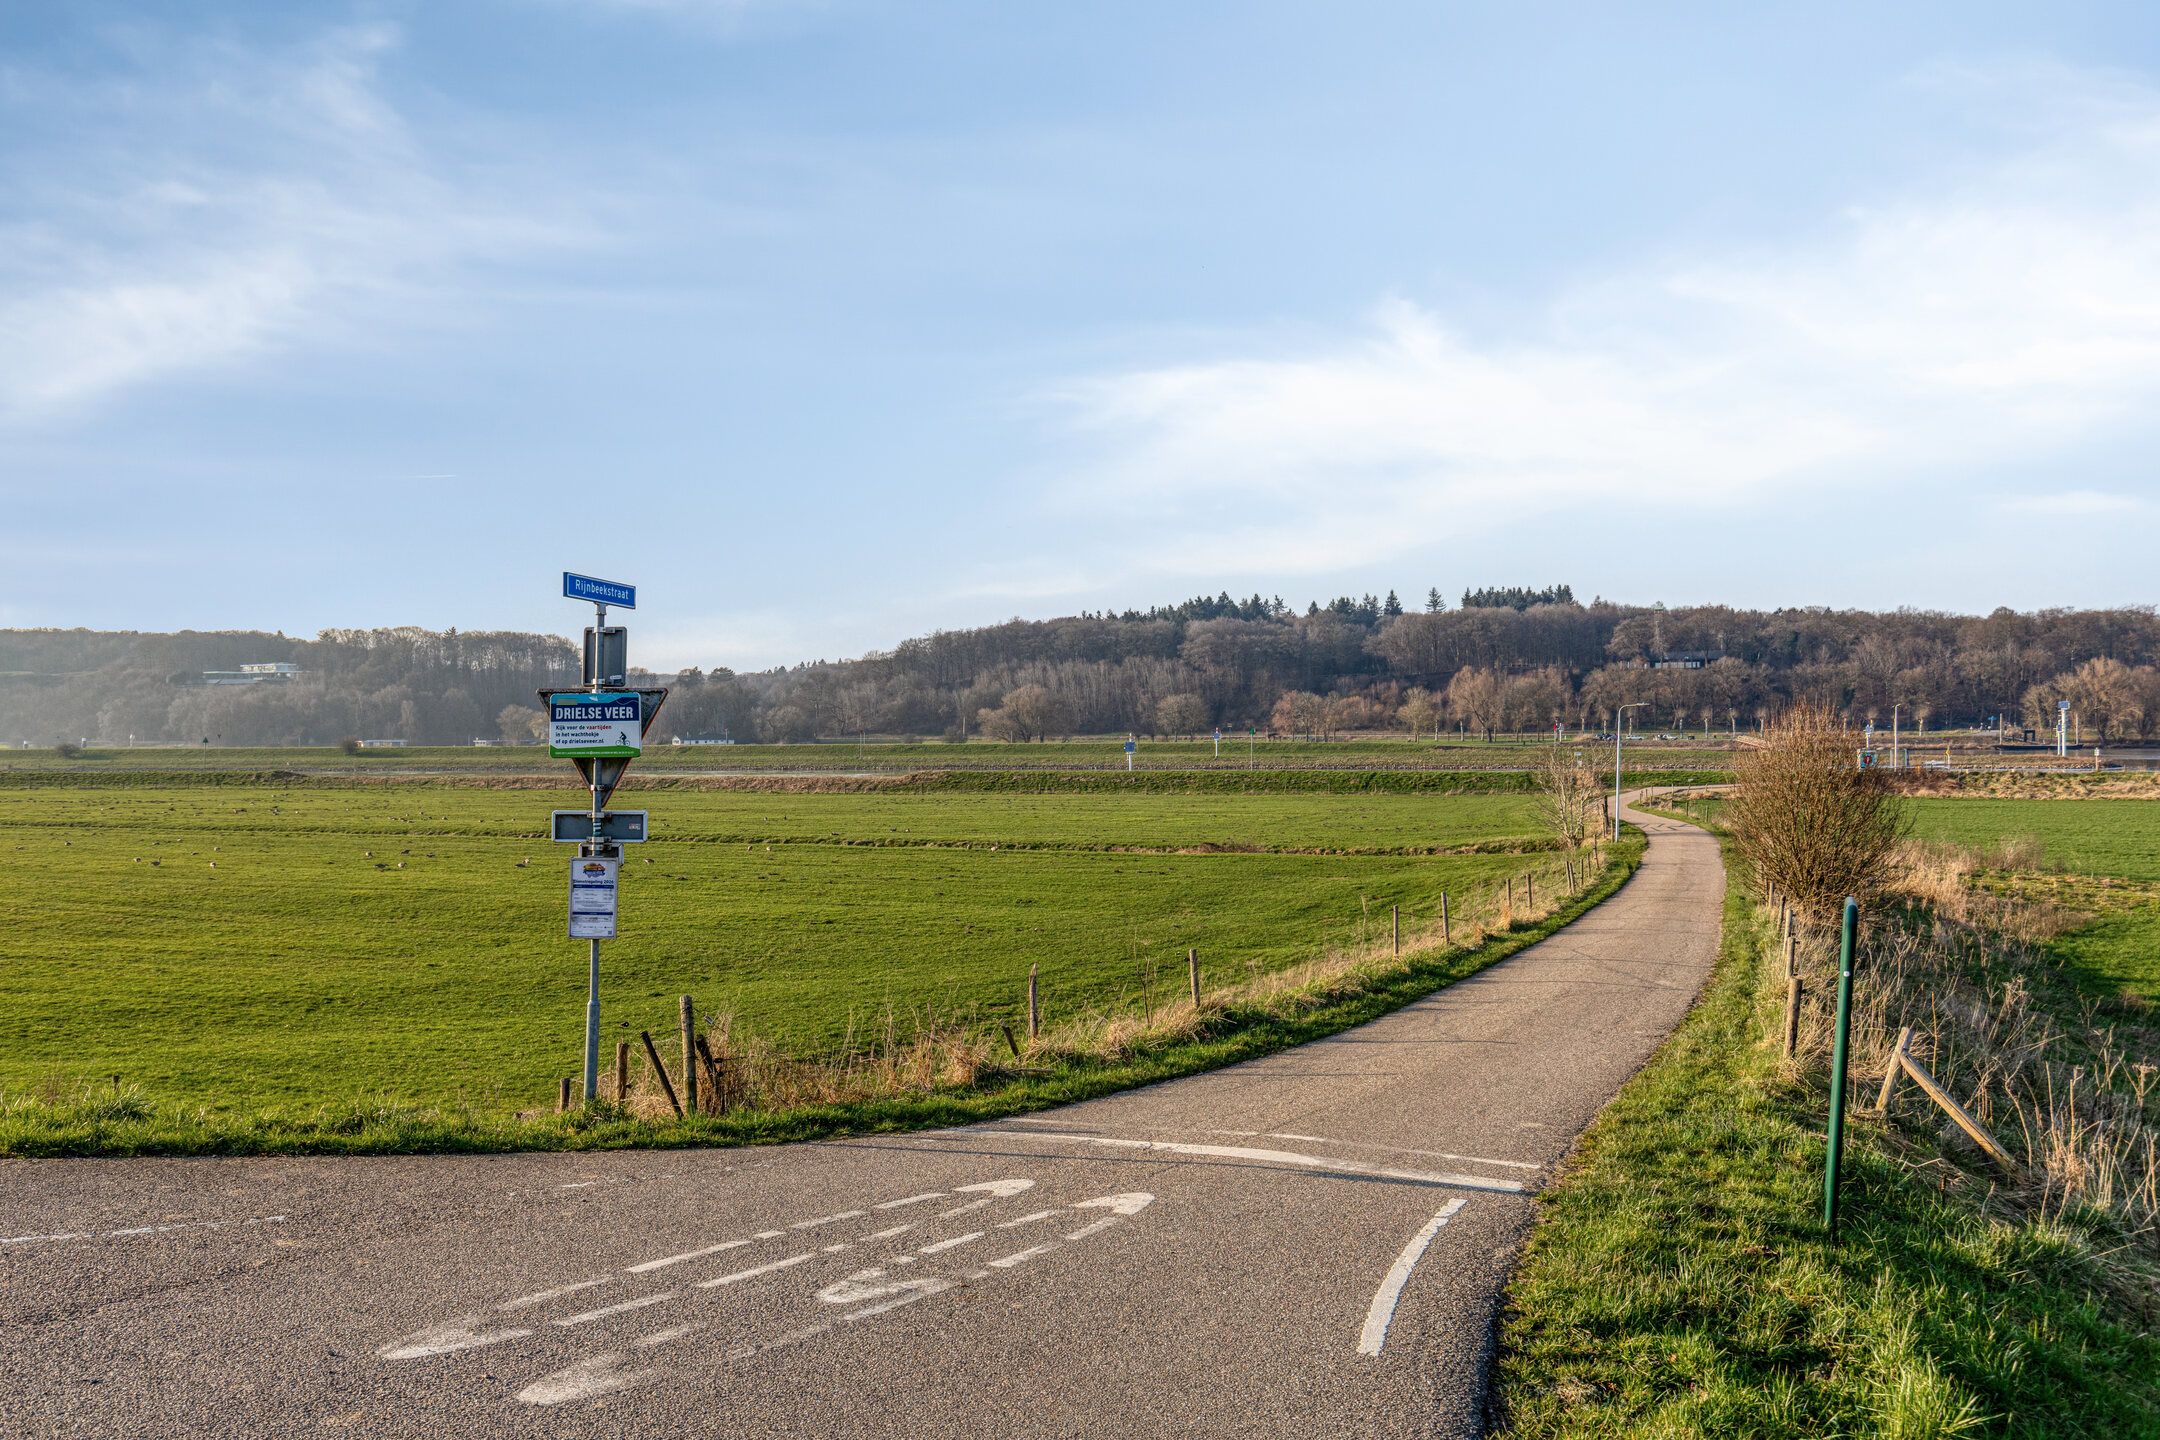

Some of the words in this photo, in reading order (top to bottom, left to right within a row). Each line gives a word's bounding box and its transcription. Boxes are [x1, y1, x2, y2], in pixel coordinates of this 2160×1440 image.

[575, 579, 629, 600] Rijnbeekstraat
[556, 707, 602, 719] DRIELSE
[605, 707, 634, 719] VEER
